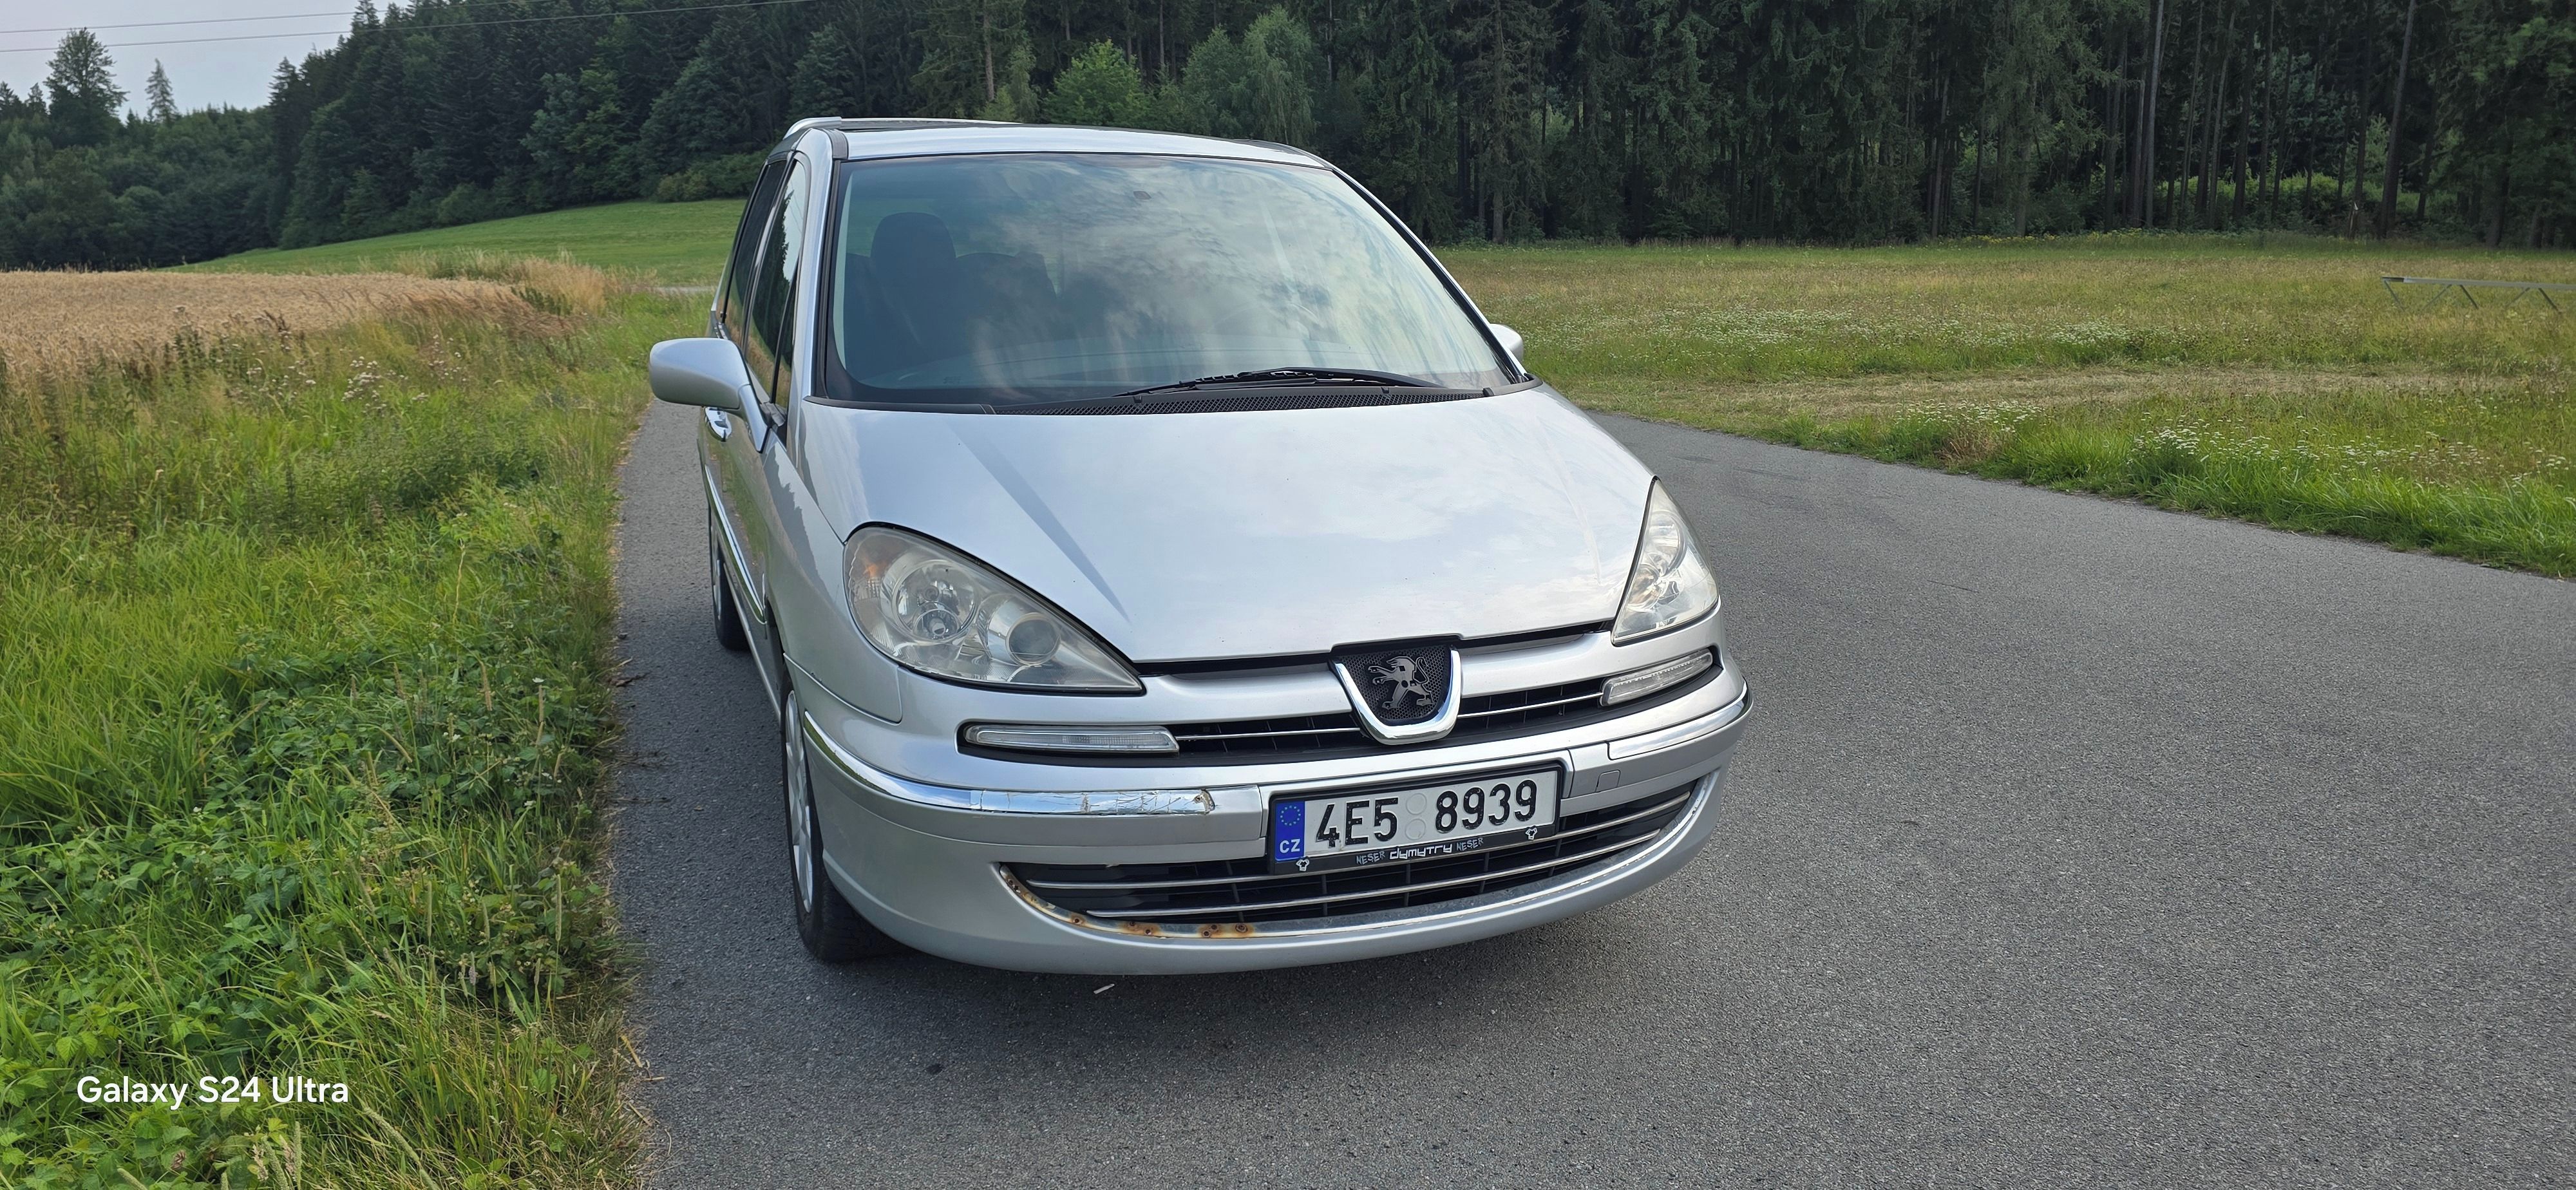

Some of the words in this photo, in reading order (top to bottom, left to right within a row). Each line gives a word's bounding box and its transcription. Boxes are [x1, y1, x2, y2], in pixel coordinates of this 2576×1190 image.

[1316, 798, 1399, 848] 4E5
[1435, 780, 1537, 833] 8939
[1280, 838, 1300, 853] CZ
